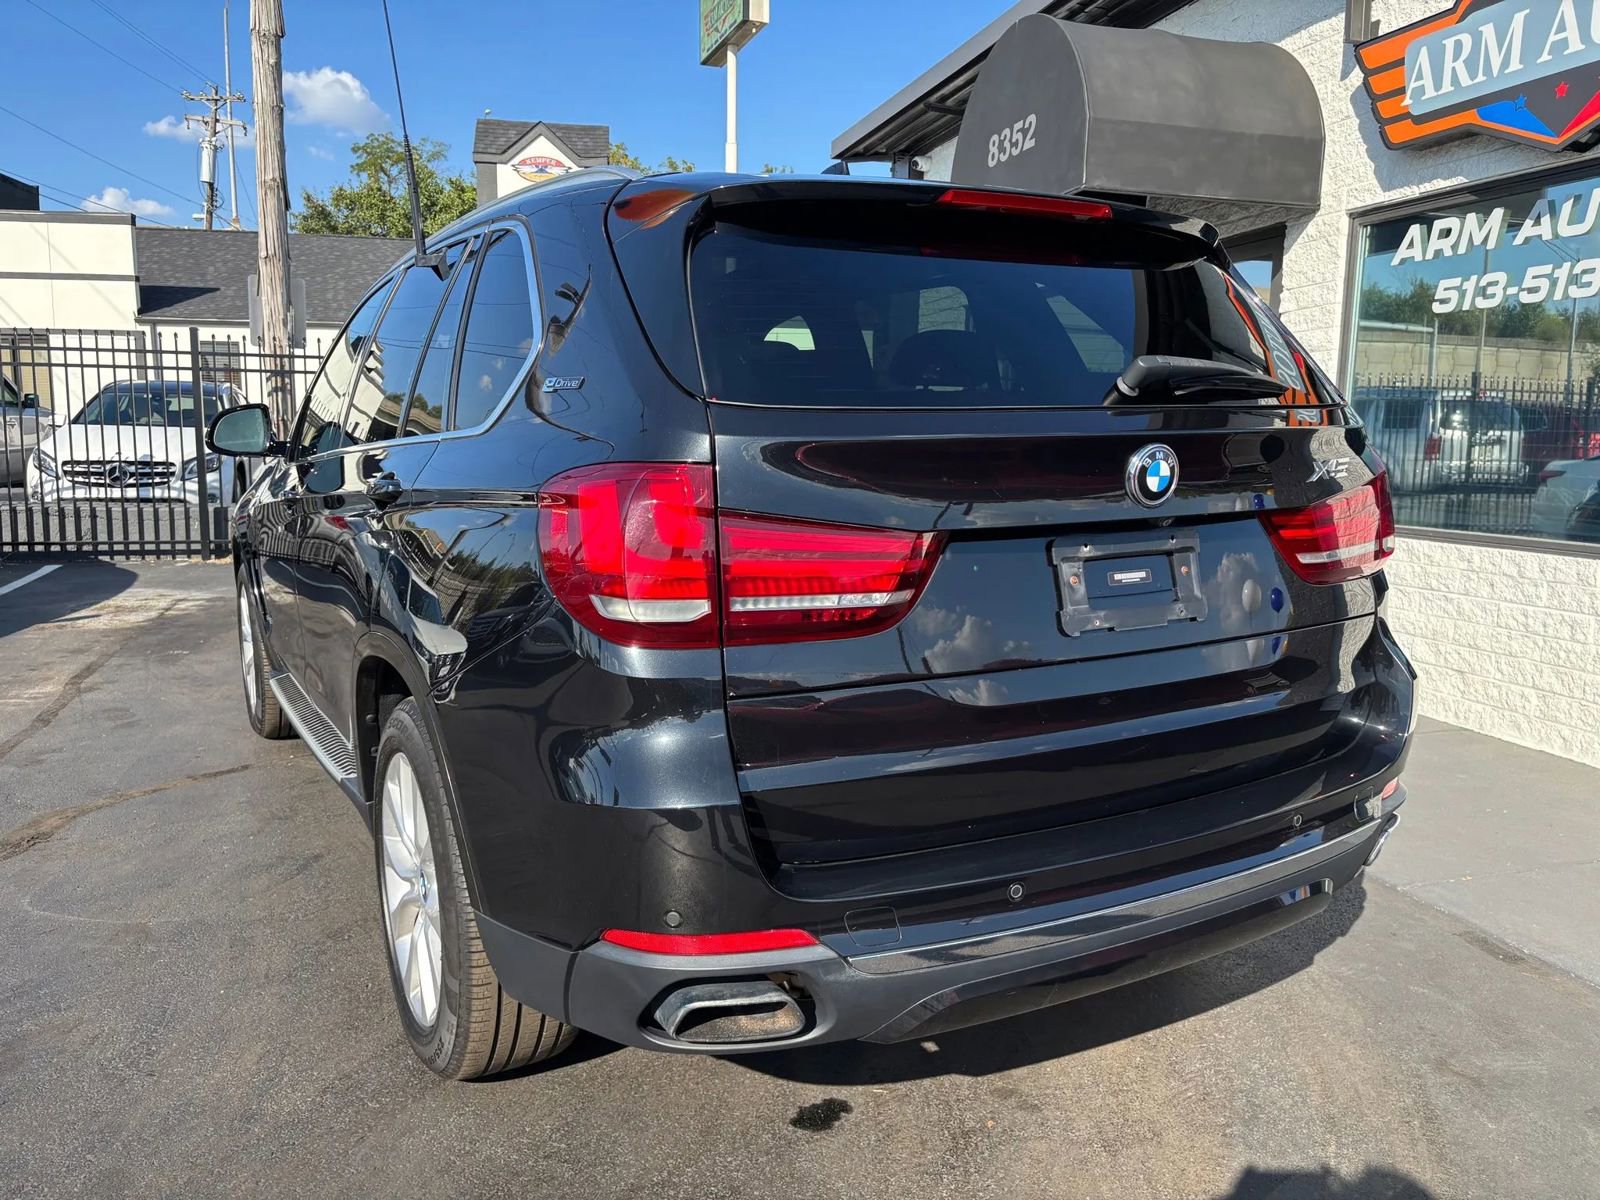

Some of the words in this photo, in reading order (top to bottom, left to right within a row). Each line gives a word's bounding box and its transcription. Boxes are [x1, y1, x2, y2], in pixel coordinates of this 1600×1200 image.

[1400, 8, 1530, 107] ARM
[987, 113, 1037, 168] 8352
[1391, 206, 1505, 266] ARM
[1431, 258, 1600, 315] 513-513
[1142, 451, 1175, 468] BMW
[1305, 457, 1350, 482] X5
